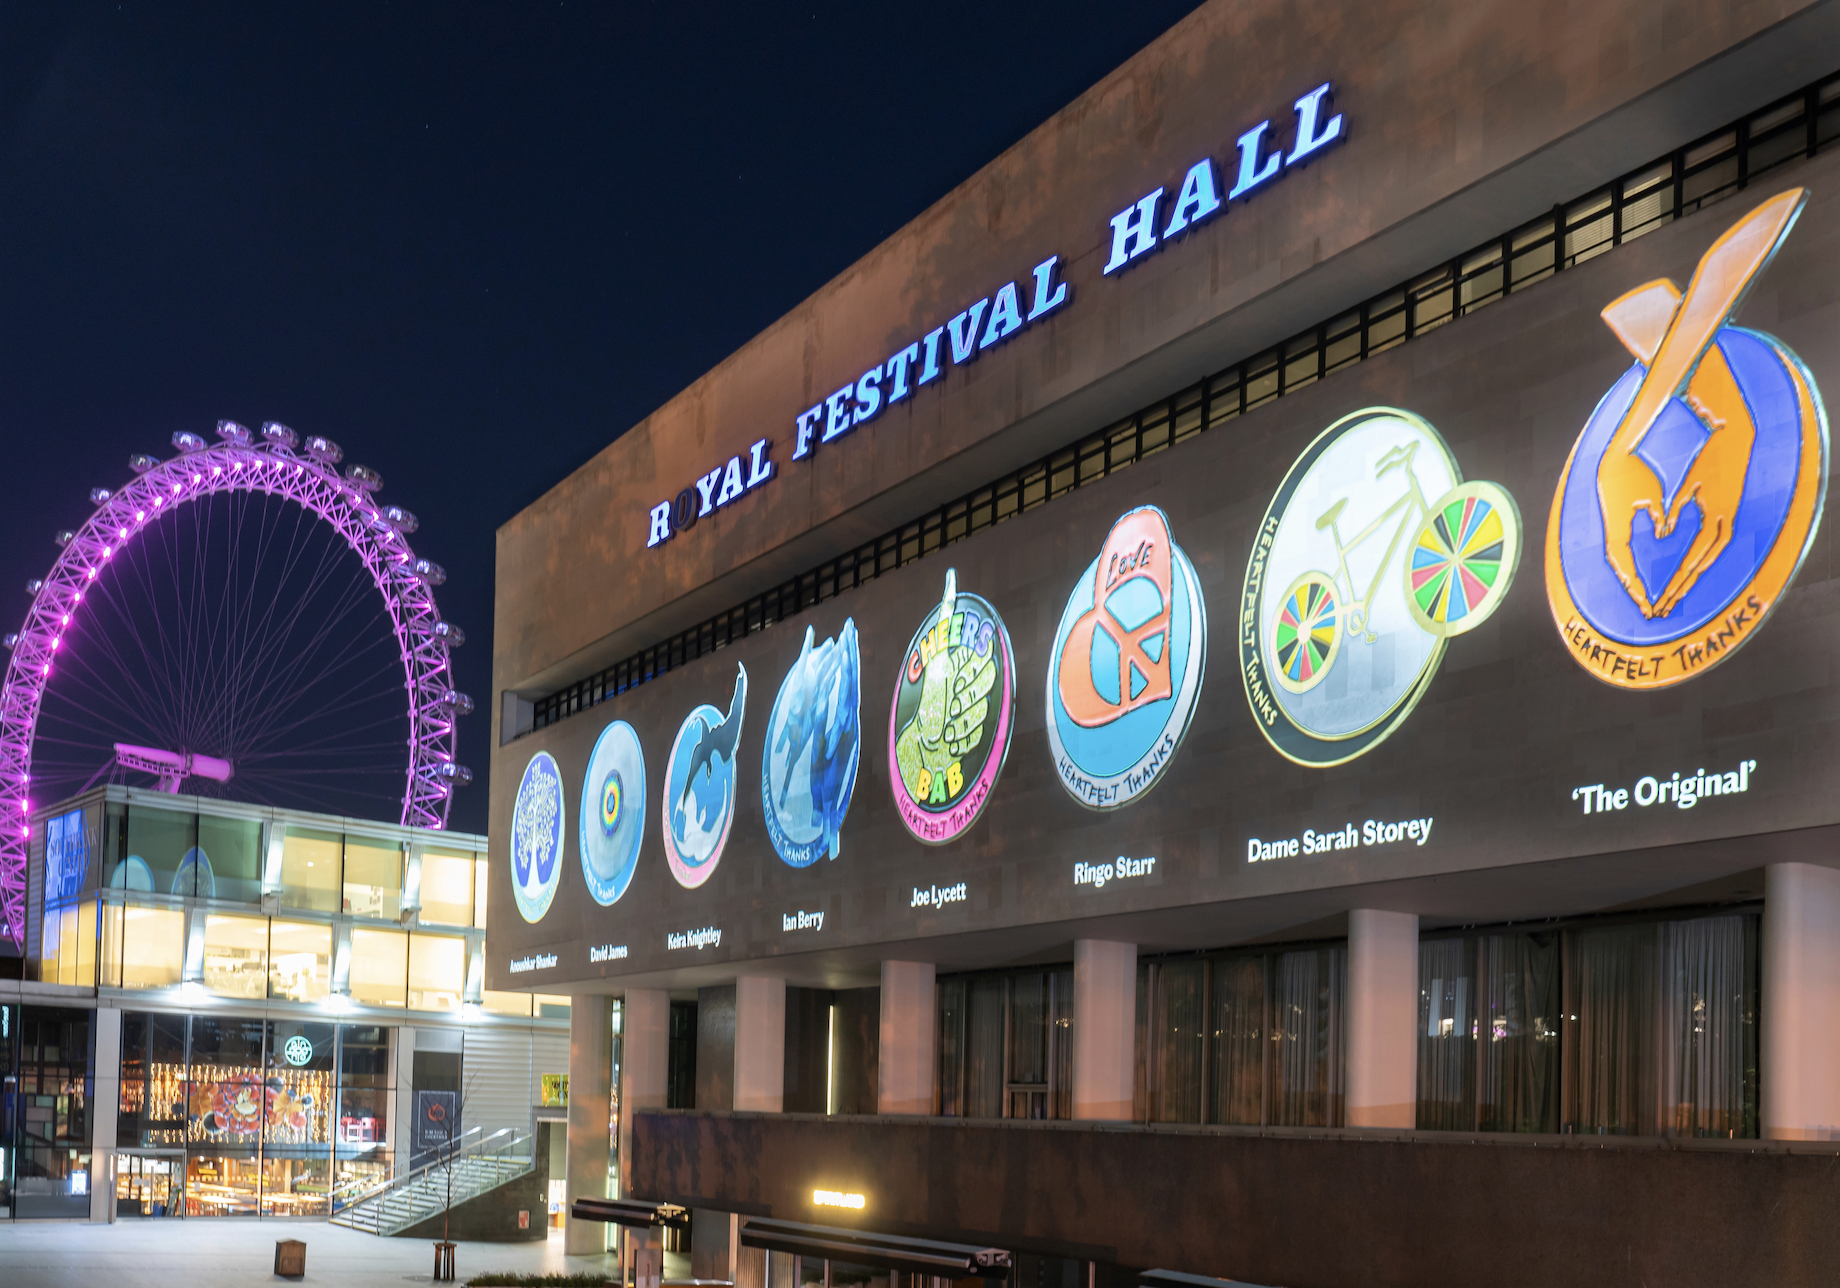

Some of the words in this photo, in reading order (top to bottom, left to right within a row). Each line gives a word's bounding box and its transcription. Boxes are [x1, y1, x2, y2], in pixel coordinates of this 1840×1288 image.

[646, 438, 773, 549] ROYAL
[792, 254, 1068, 462] FESTIVAL
[1103, 82, 1344, 276] HALL
[1242, 515, 1279, 647] HEARTFELT
[906, 611, 996, 684] CHEERS
[1563, 615, 1664, 681] HEARTFELT
[1671, 594, 1764, 672] THANKS
[1245, 650, 1279, 727] THANKS
[916, 761, 965, 805] BAB
[1058, 755, 1119, 804] HEARTFELT
[1122, 732, 1174, 794] THANKS
[762, 774, 783, 849] HEARTFELT
[783, 840, 812, 862] THANKS
[898, 796, 947, 839] HEARTFELT
[948, 780, 989, 833] THANKS
[1247, 836, 1299, 863] Dame
[1302, 823, 1359, 855] Sarah
[1363, 816, 1434, 846] Storey
[910, 886, 930, 908] Joe
[931, 882, 967, 910] Lycett
[1073, 858, 1114, 888] Ringo
[1116, 855, 1156, 878] Starr
[667, 932, 686, 950] Keira
[687, 926, 722, 950] Knightley
[782, 912, 797, 931] Ian
[798, 909, 825, 932] Berry
[535, 952, 558, 970] Shankar
[590, 944, 607, 962] David
[608, 943, 628, 960] James
